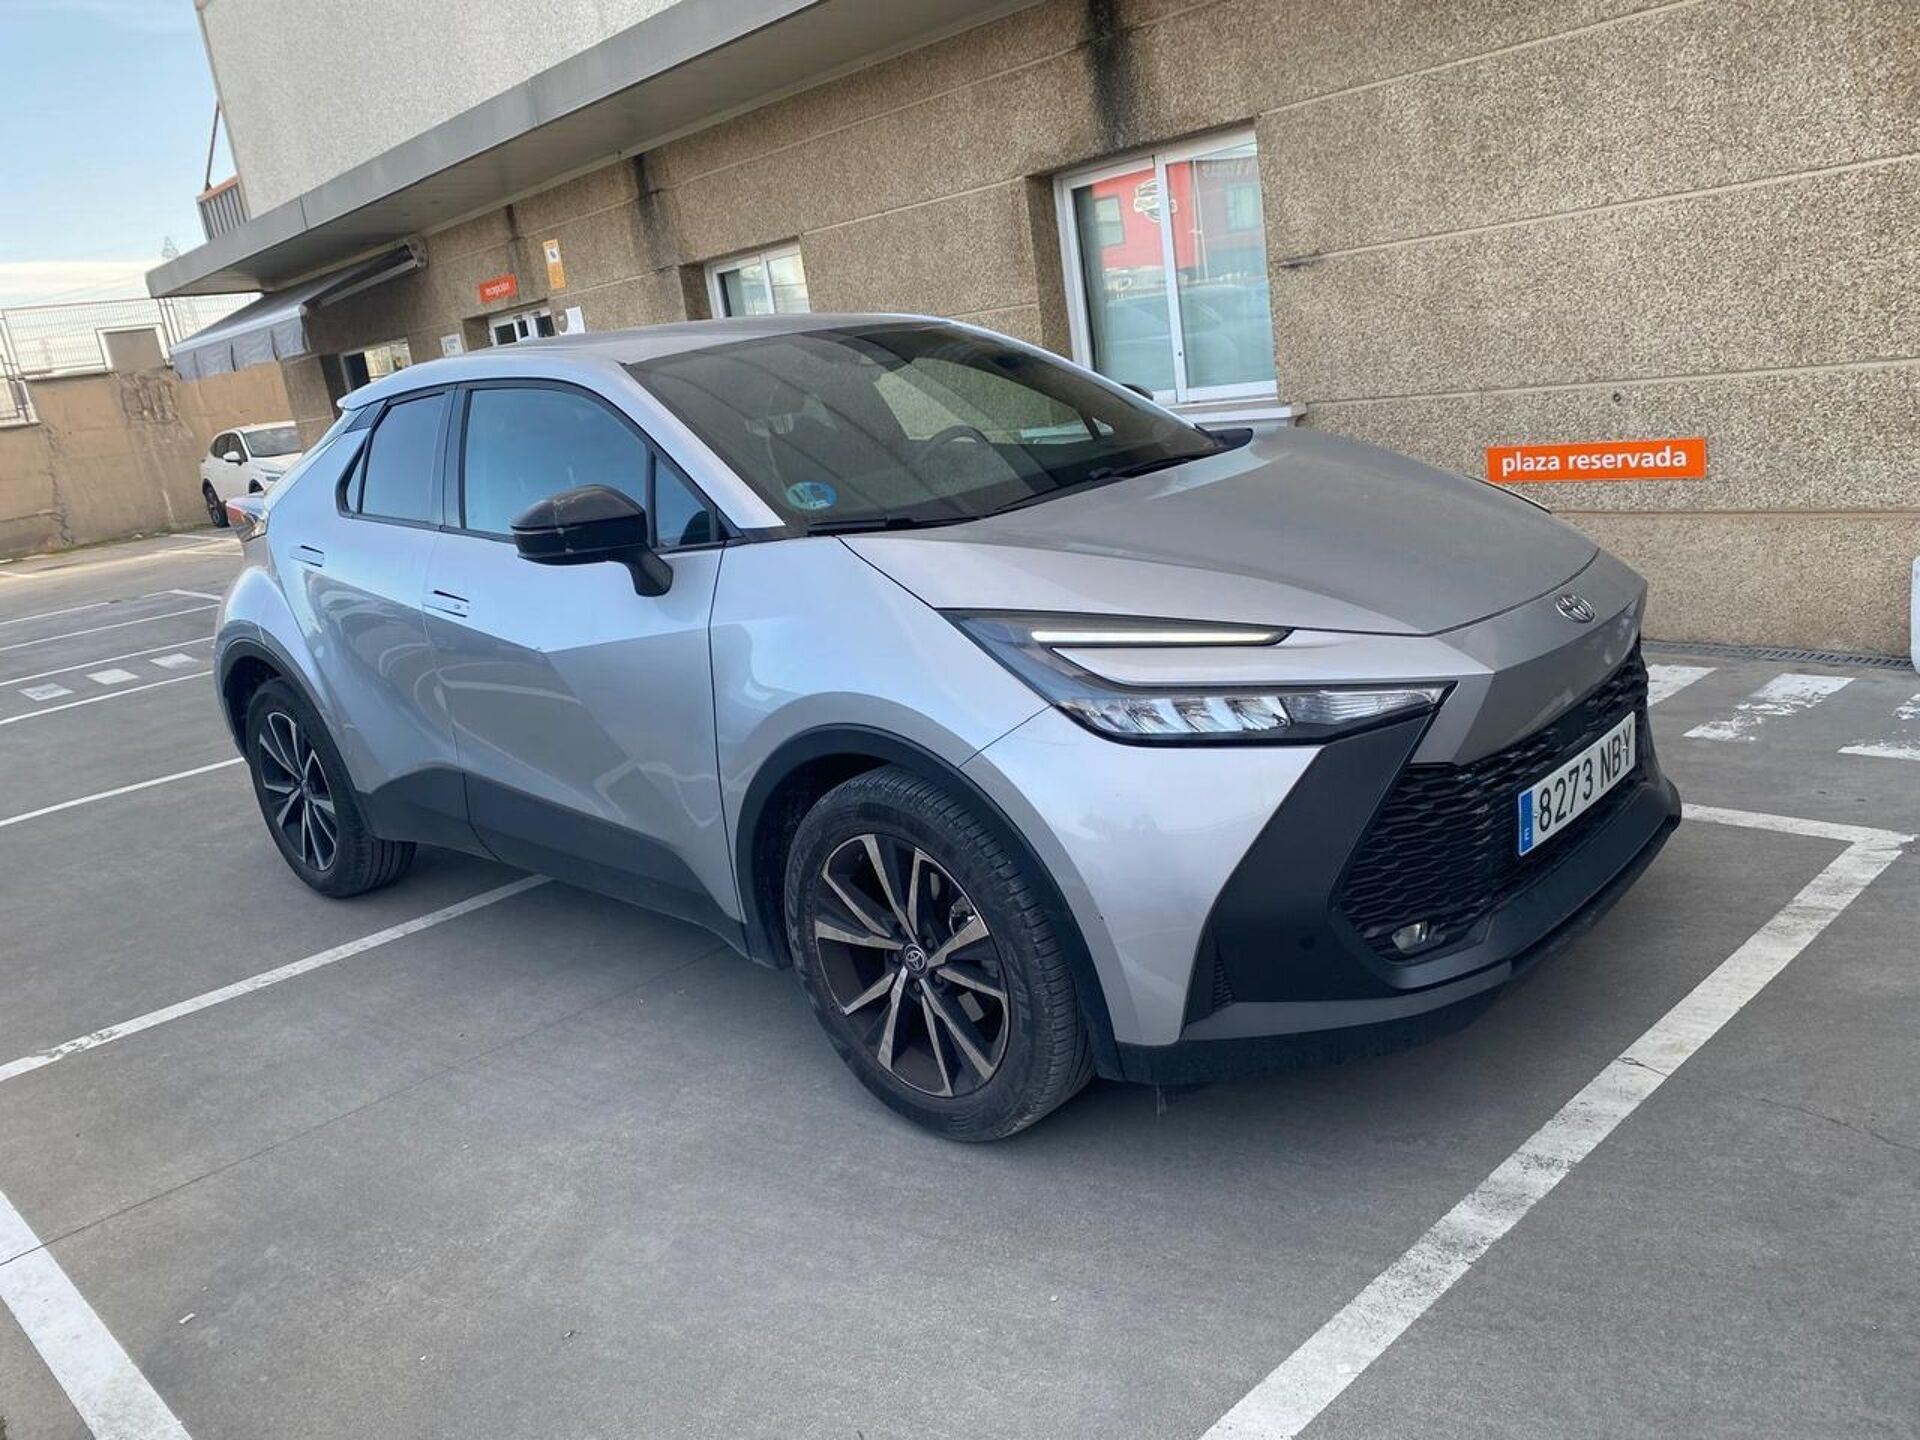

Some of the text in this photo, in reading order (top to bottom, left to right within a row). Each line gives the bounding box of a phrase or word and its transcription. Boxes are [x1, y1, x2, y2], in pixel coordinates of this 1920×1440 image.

[1502, 446, 1687, 477] plaza reservada
[1538, 724, 1632, 832] 8273 NBY
